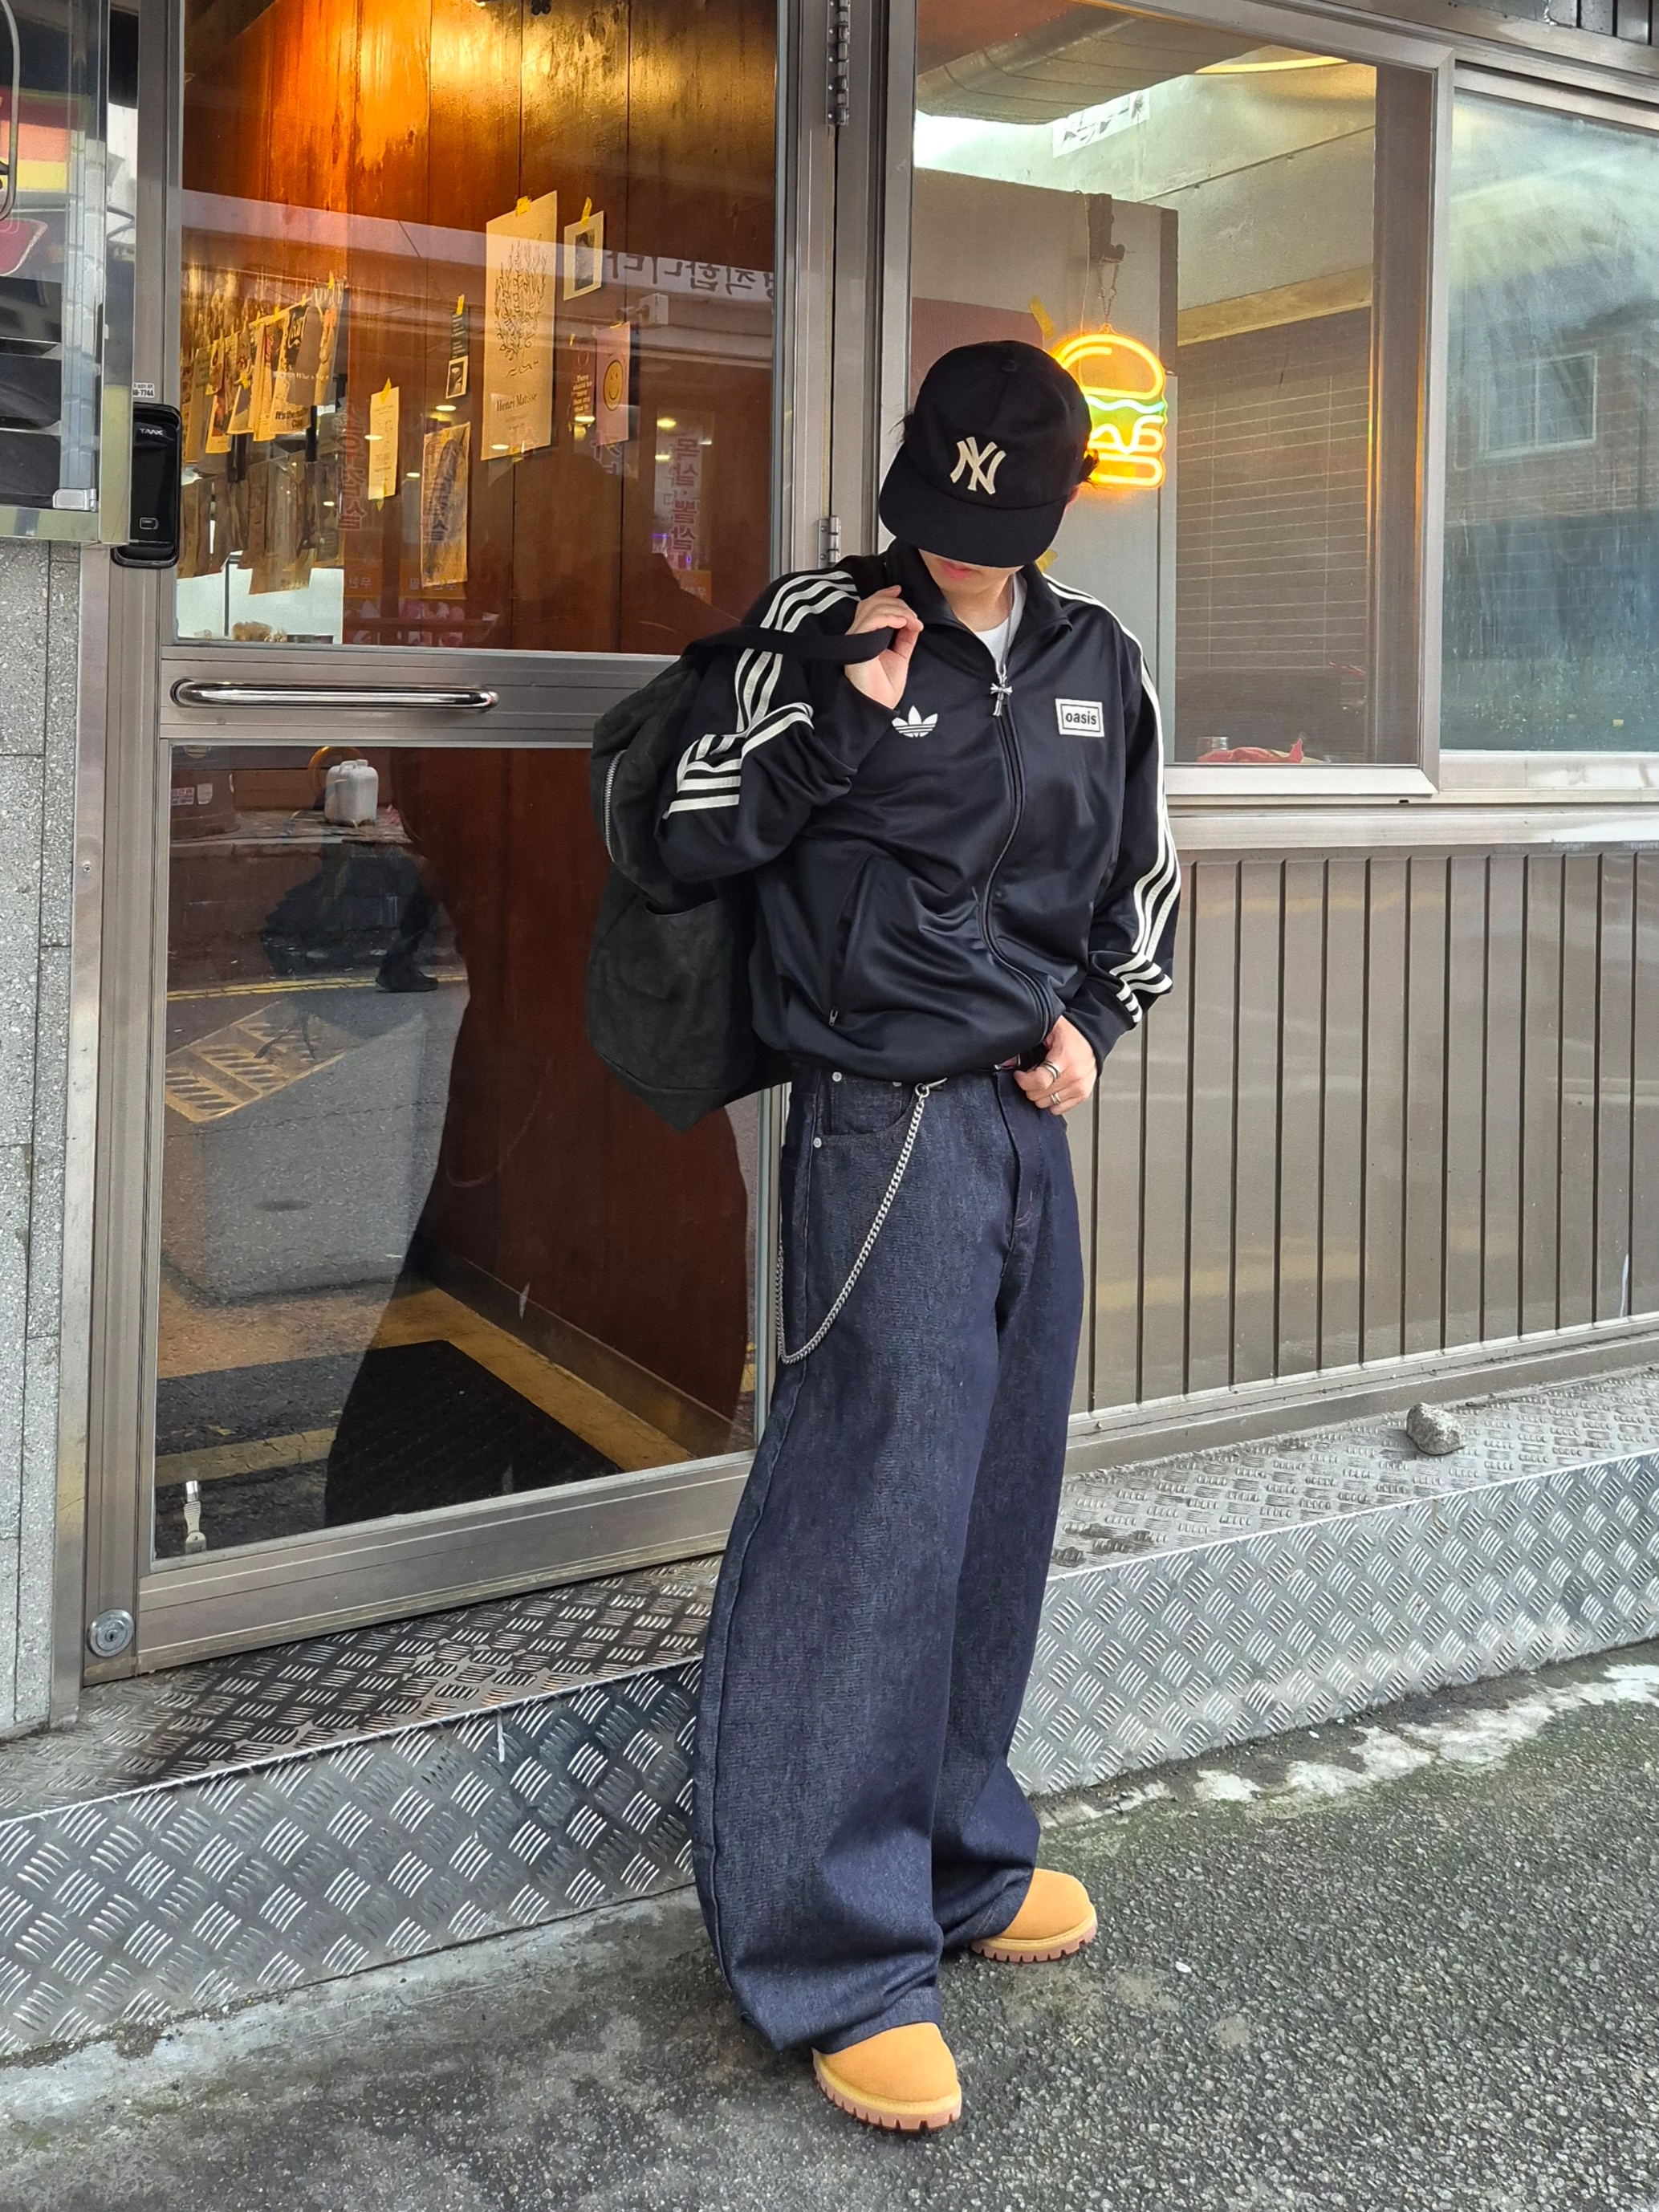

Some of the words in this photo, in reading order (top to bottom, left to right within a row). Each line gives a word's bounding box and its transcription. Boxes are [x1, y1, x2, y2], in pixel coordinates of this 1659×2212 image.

[496, 396, 515, 412] Henri
[515, 392, 538, 408] Matisse
[139, 428, 164, 436] TANK
[950, 436, 1006, 495] NY
[1065, 710, 1097, 725] oasis
